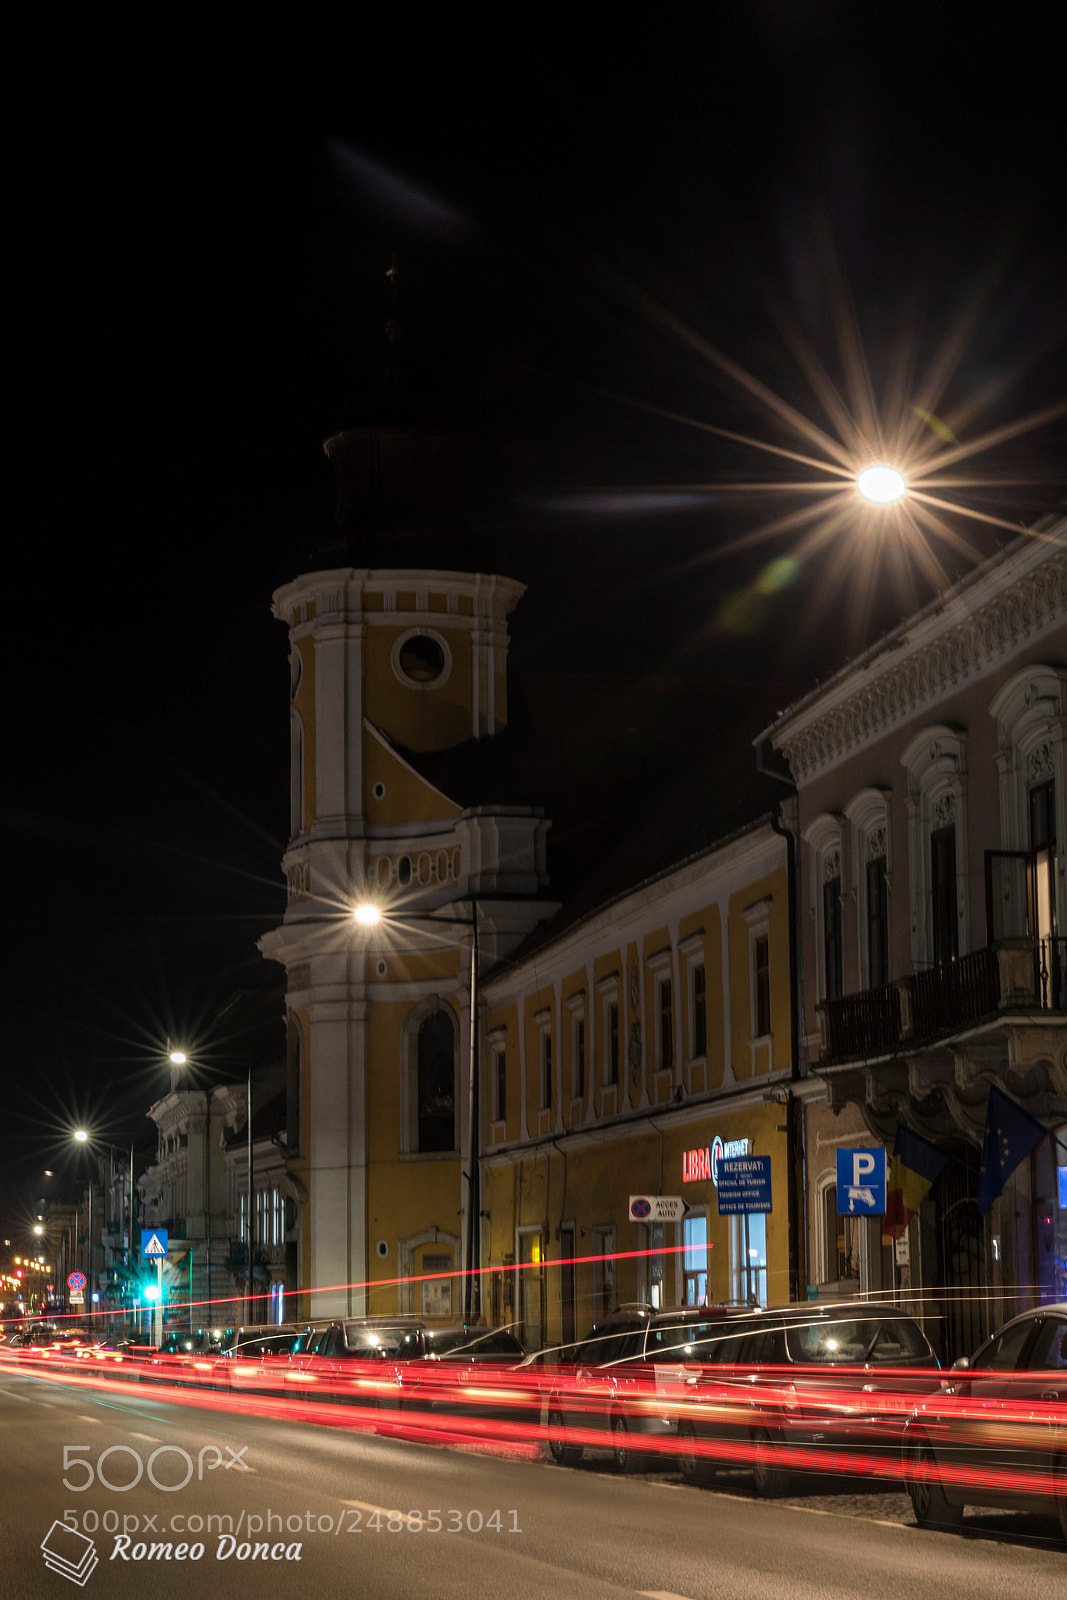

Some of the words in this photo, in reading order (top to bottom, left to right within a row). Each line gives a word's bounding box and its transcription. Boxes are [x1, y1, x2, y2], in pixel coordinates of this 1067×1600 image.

[682, 1147, 711, 1183] LIBRA
[853, 1152, 875, 1186] P
[719, 1191, 741, 1199] TOURISM
[742, 1190, 760, 1198] OFFICE
[656, 1199, 678, 1209] ACCES
[720, 1203, 737, 1211] OFFICE
[658, 1209, 676, 1218] AUTO
